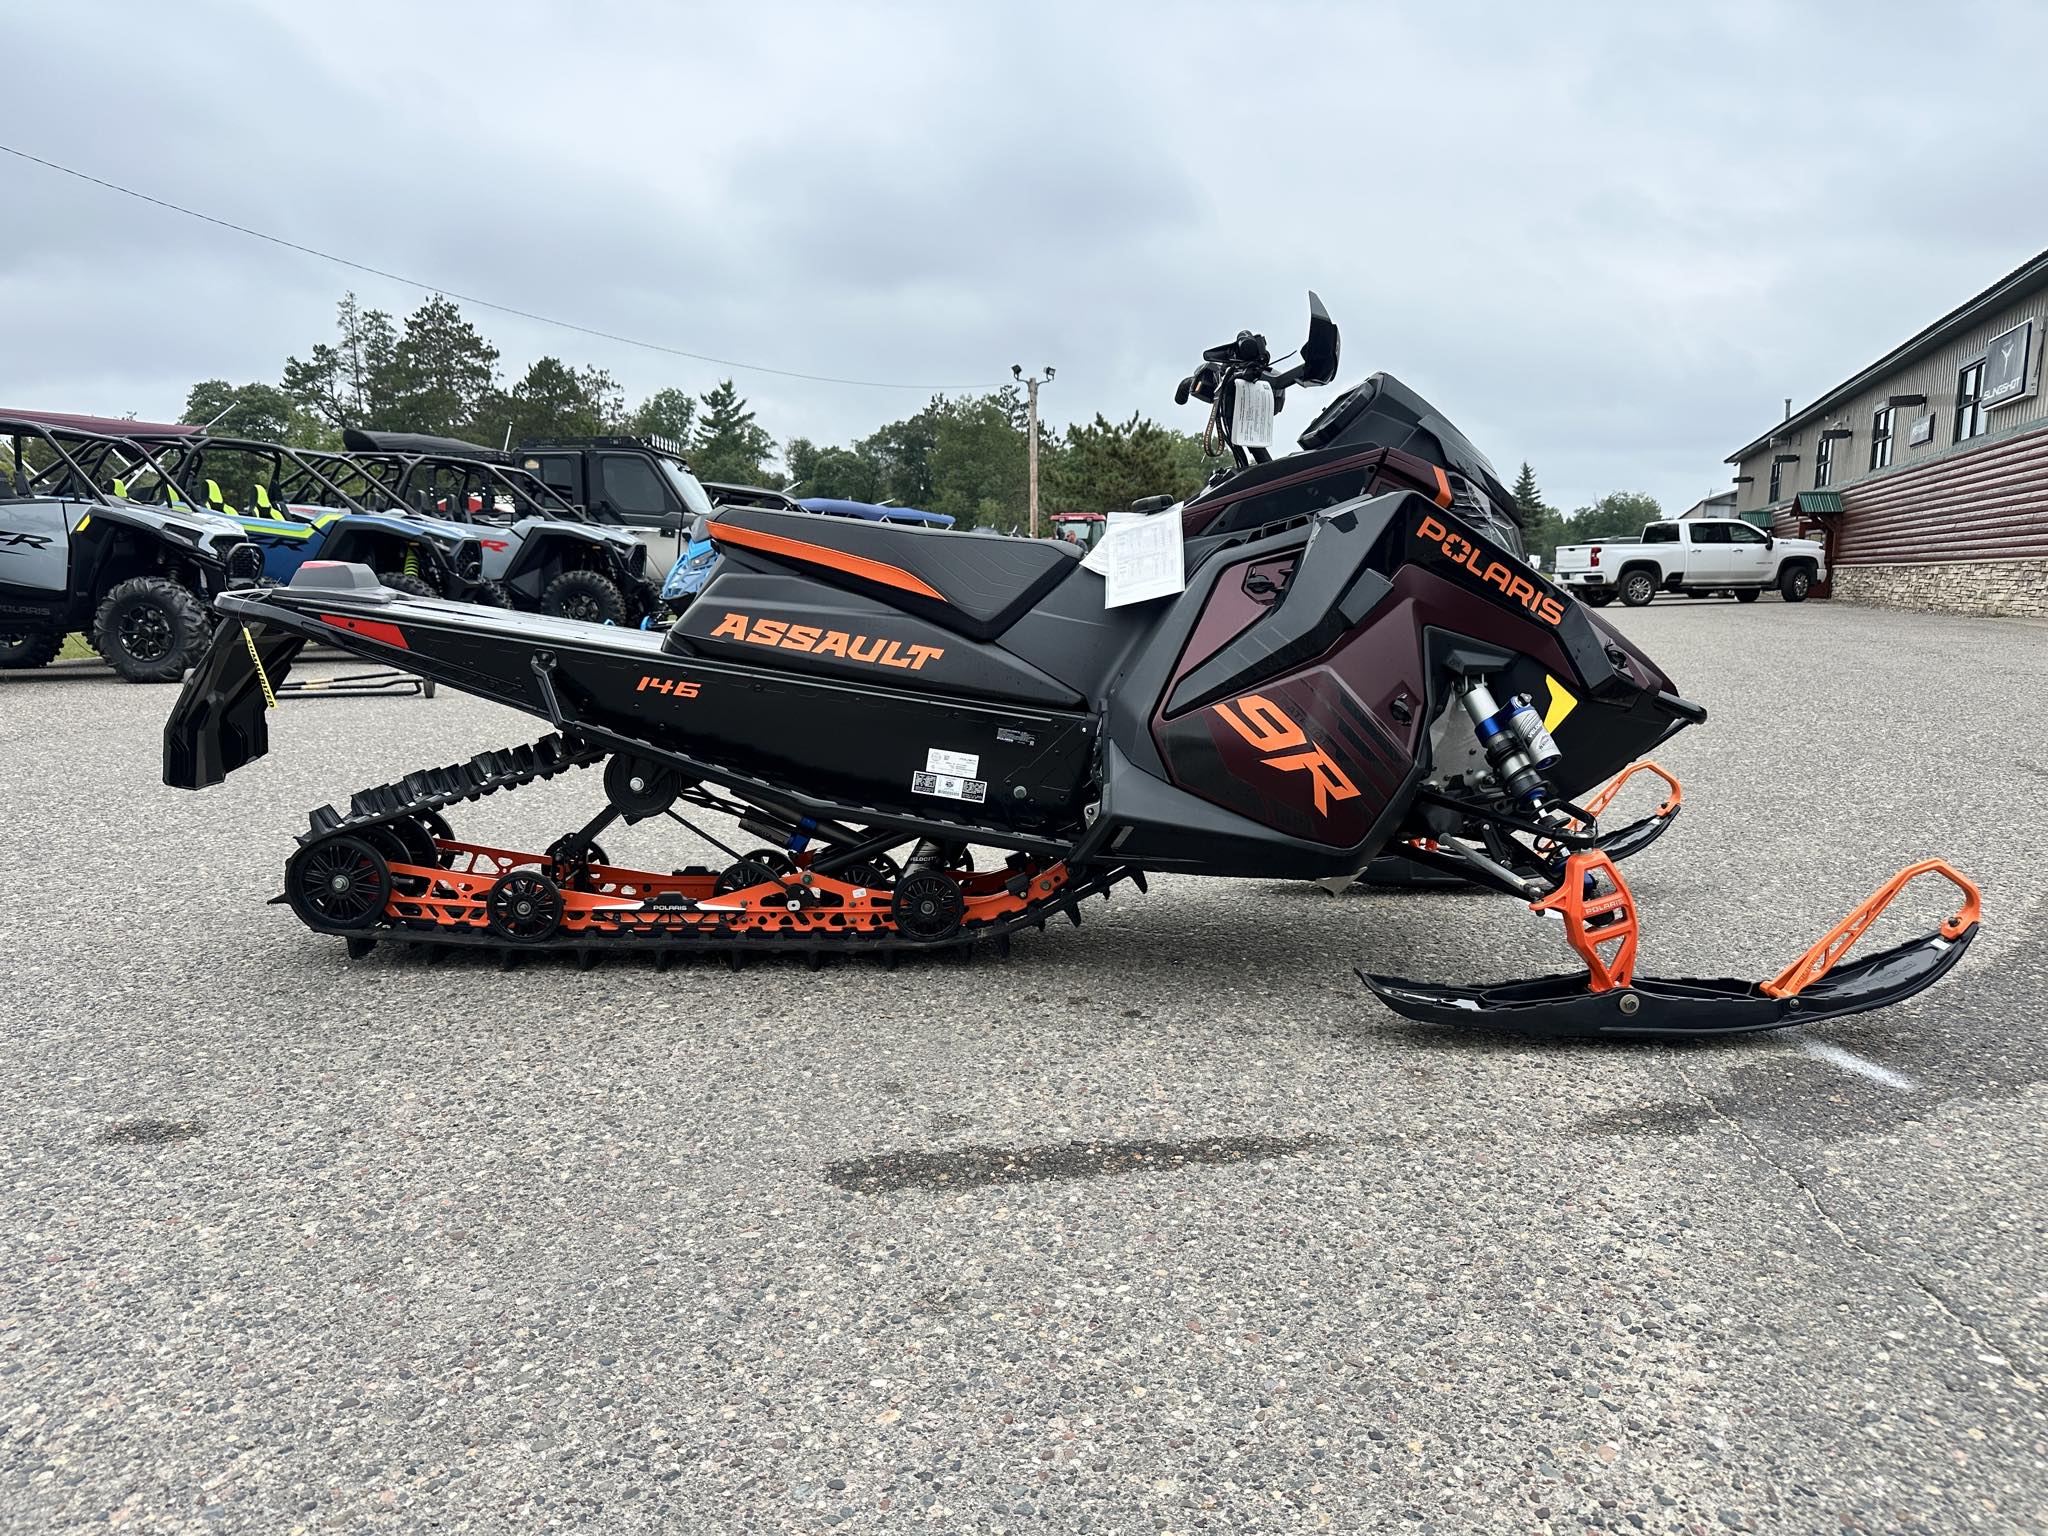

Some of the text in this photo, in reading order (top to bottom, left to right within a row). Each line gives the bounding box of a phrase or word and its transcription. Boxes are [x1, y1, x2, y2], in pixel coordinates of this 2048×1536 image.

[1416, 516, 1565, 625] POLARIS
[710, 613, 944, 670] ASSAULT
[636, 676, 701, 698] 146
[1585, 899, 1624, 914] POLARIS
